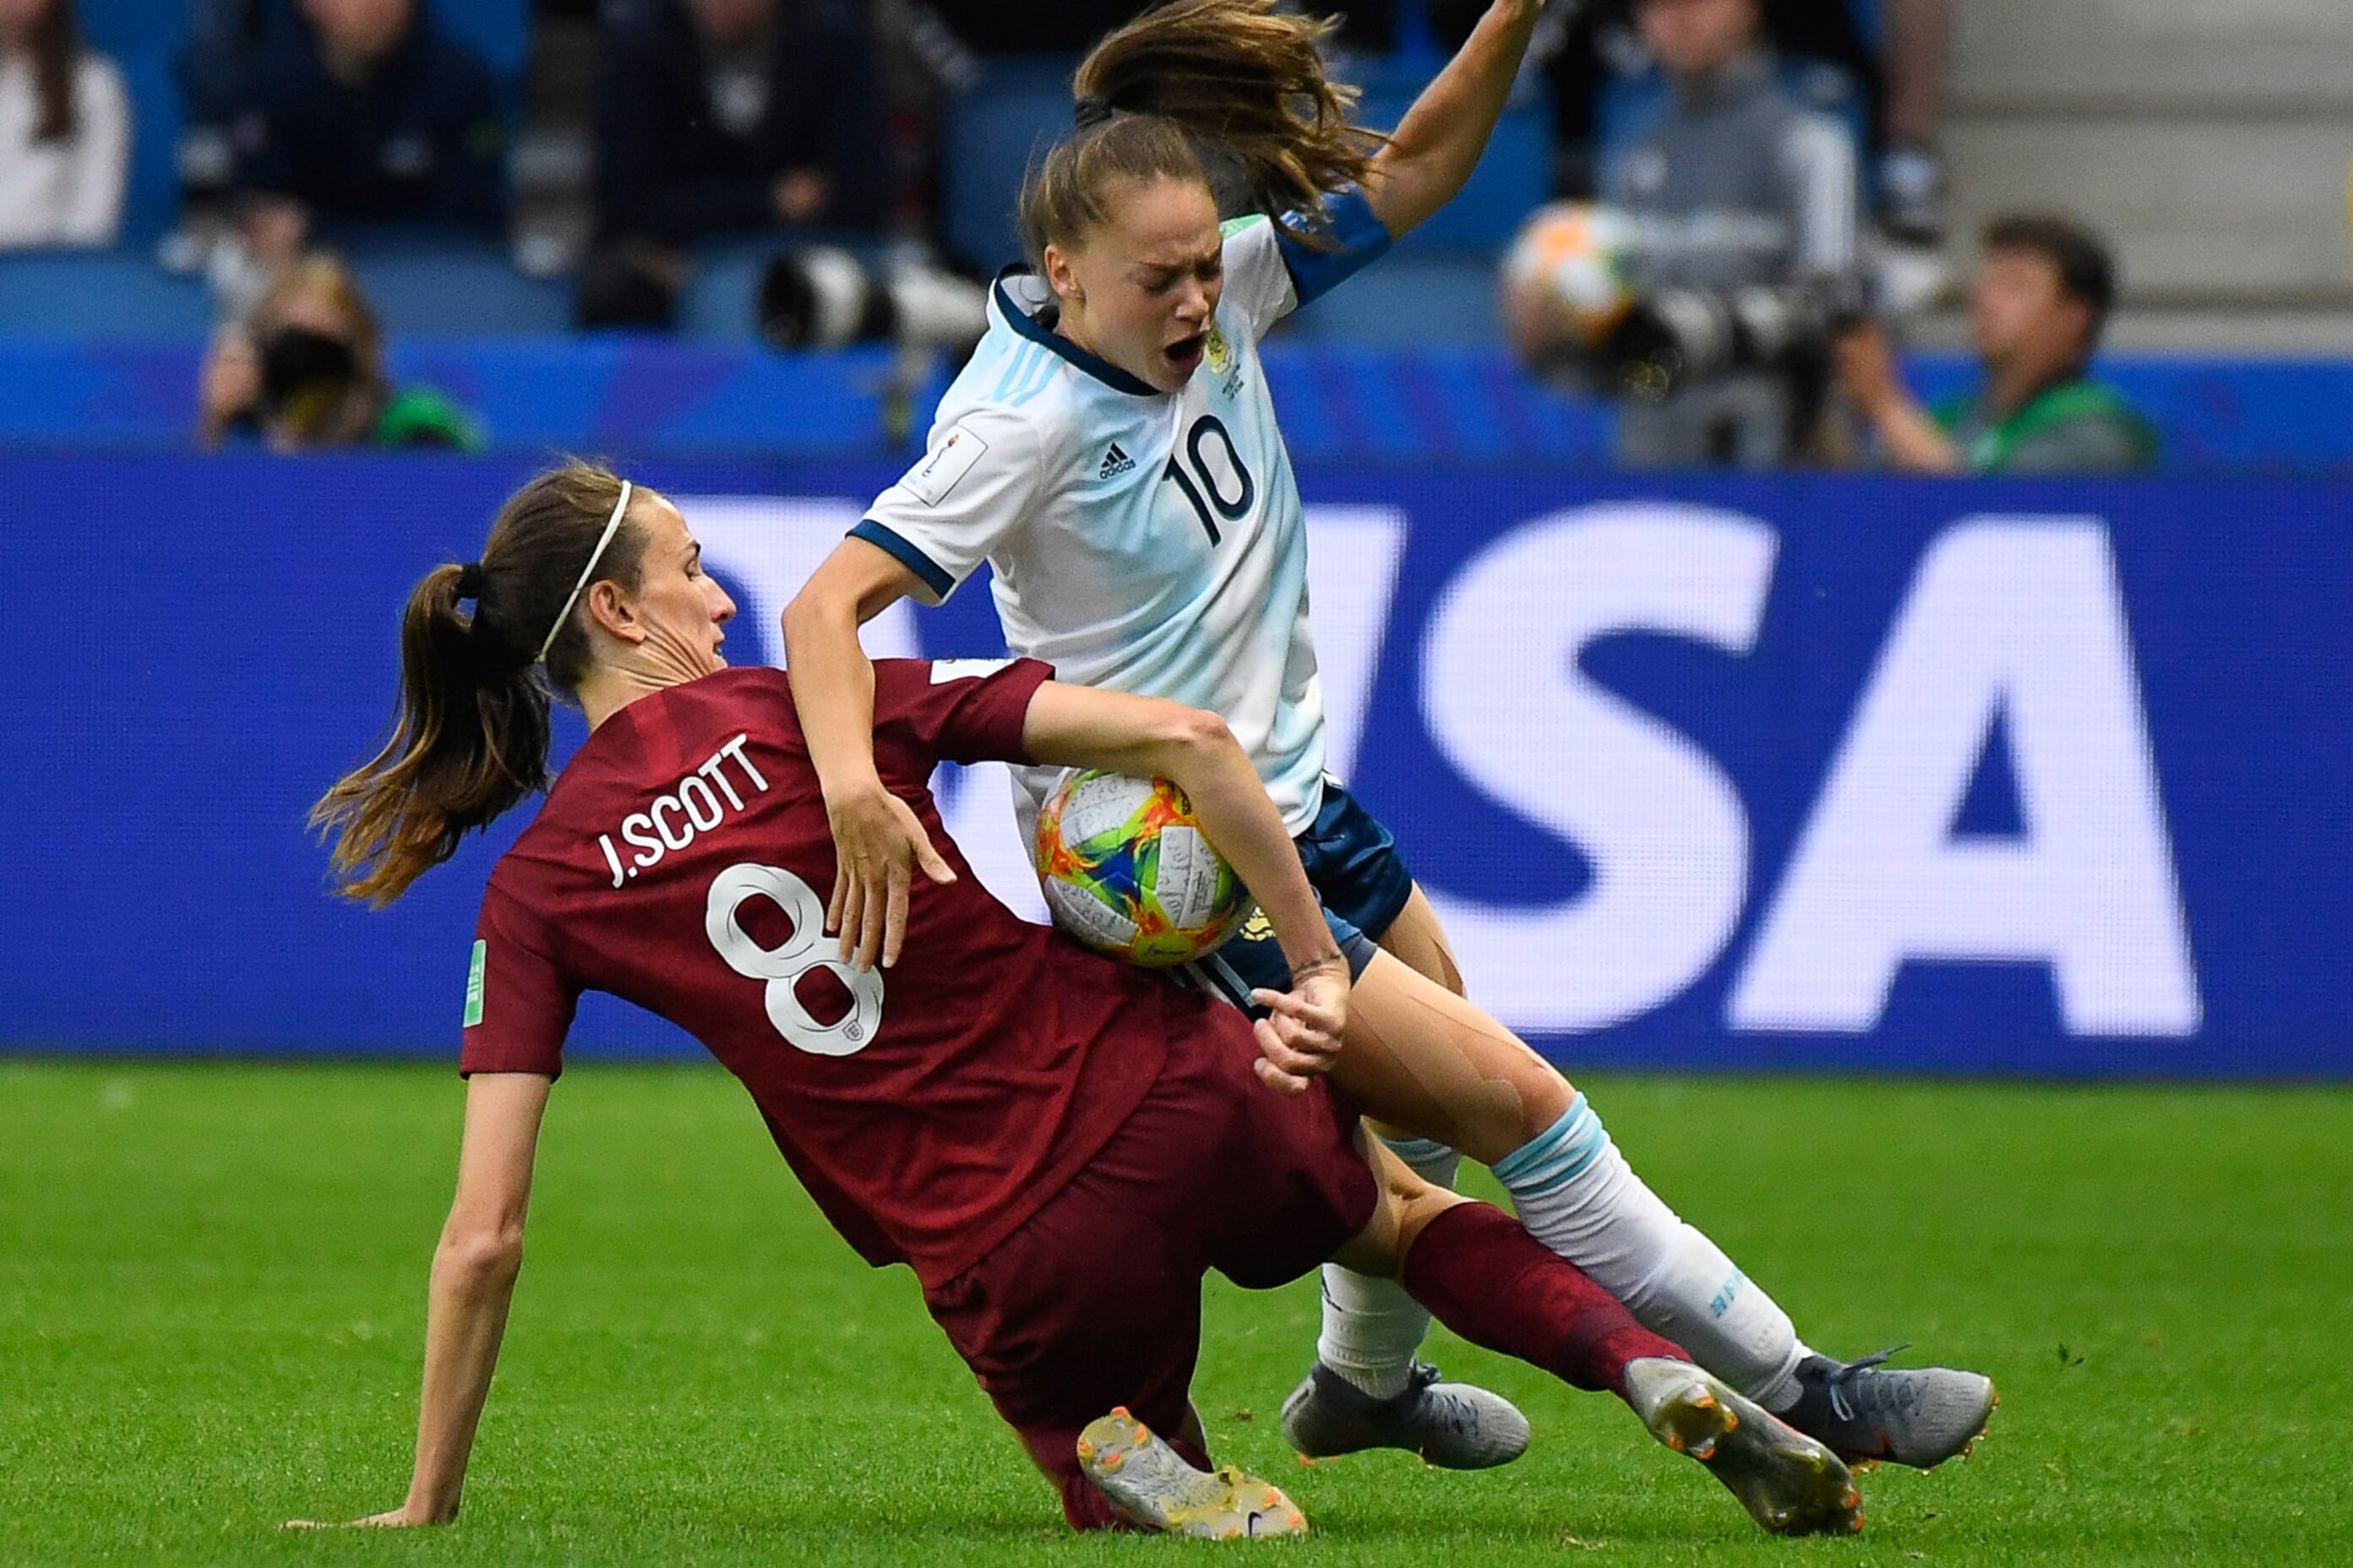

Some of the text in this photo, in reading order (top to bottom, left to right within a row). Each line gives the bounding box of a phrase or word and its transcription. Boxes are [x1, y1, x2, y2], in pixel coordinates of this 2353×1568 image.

[1099, 459, 1136, 480] adidas
[1162, 414, 1255, 548] 10
[598, 733, 769, 888] J.SCOTT
[669, 497, 2204, 1037] SA
[705, 863, 885, 1056] 8
